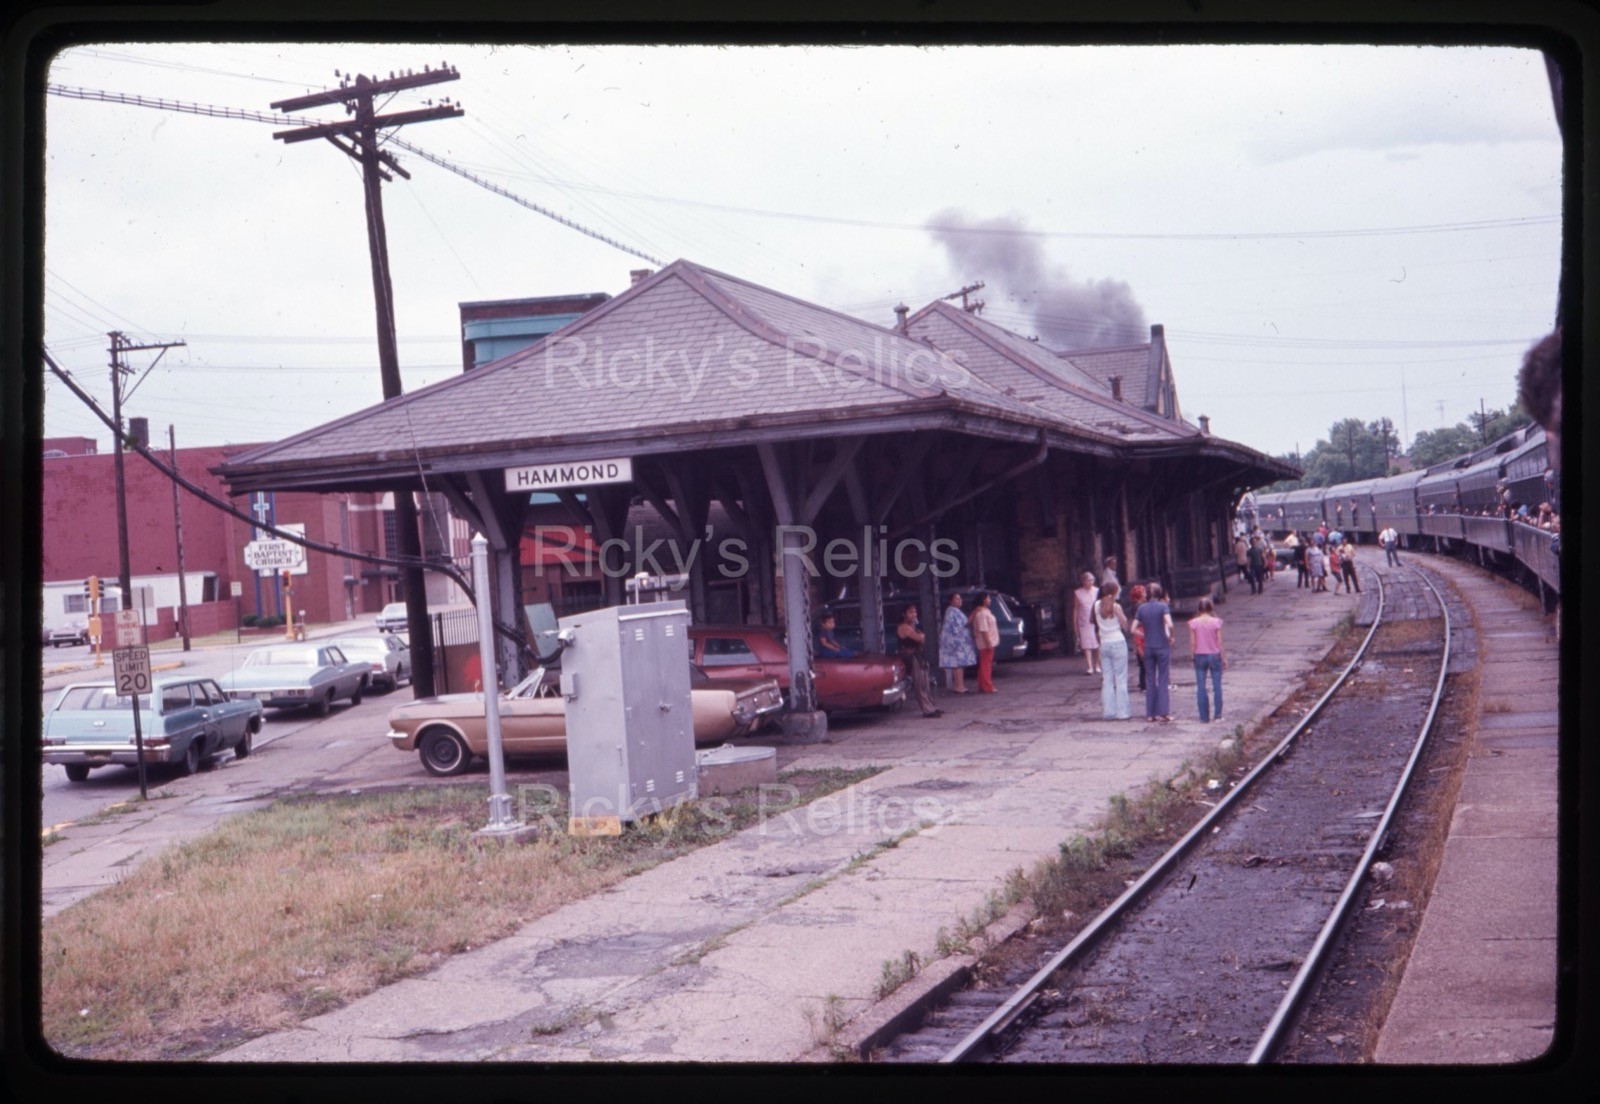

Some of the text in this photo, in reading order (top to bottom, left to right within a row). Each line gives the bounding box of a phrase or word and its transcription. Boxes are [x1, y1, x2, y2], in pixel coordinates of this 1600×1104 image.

[517, 463, 619, 486] HAMMOND
[258, 543, 286, 551] FIRST
[253, 550, 293, 559] BAPTIST
[255, 558, 292, 566] CHURCH
[115, 650, 147, 662] SPEED
[119, 662, 144, 673] LIMIT
[120, 672, 147, 692] 20
